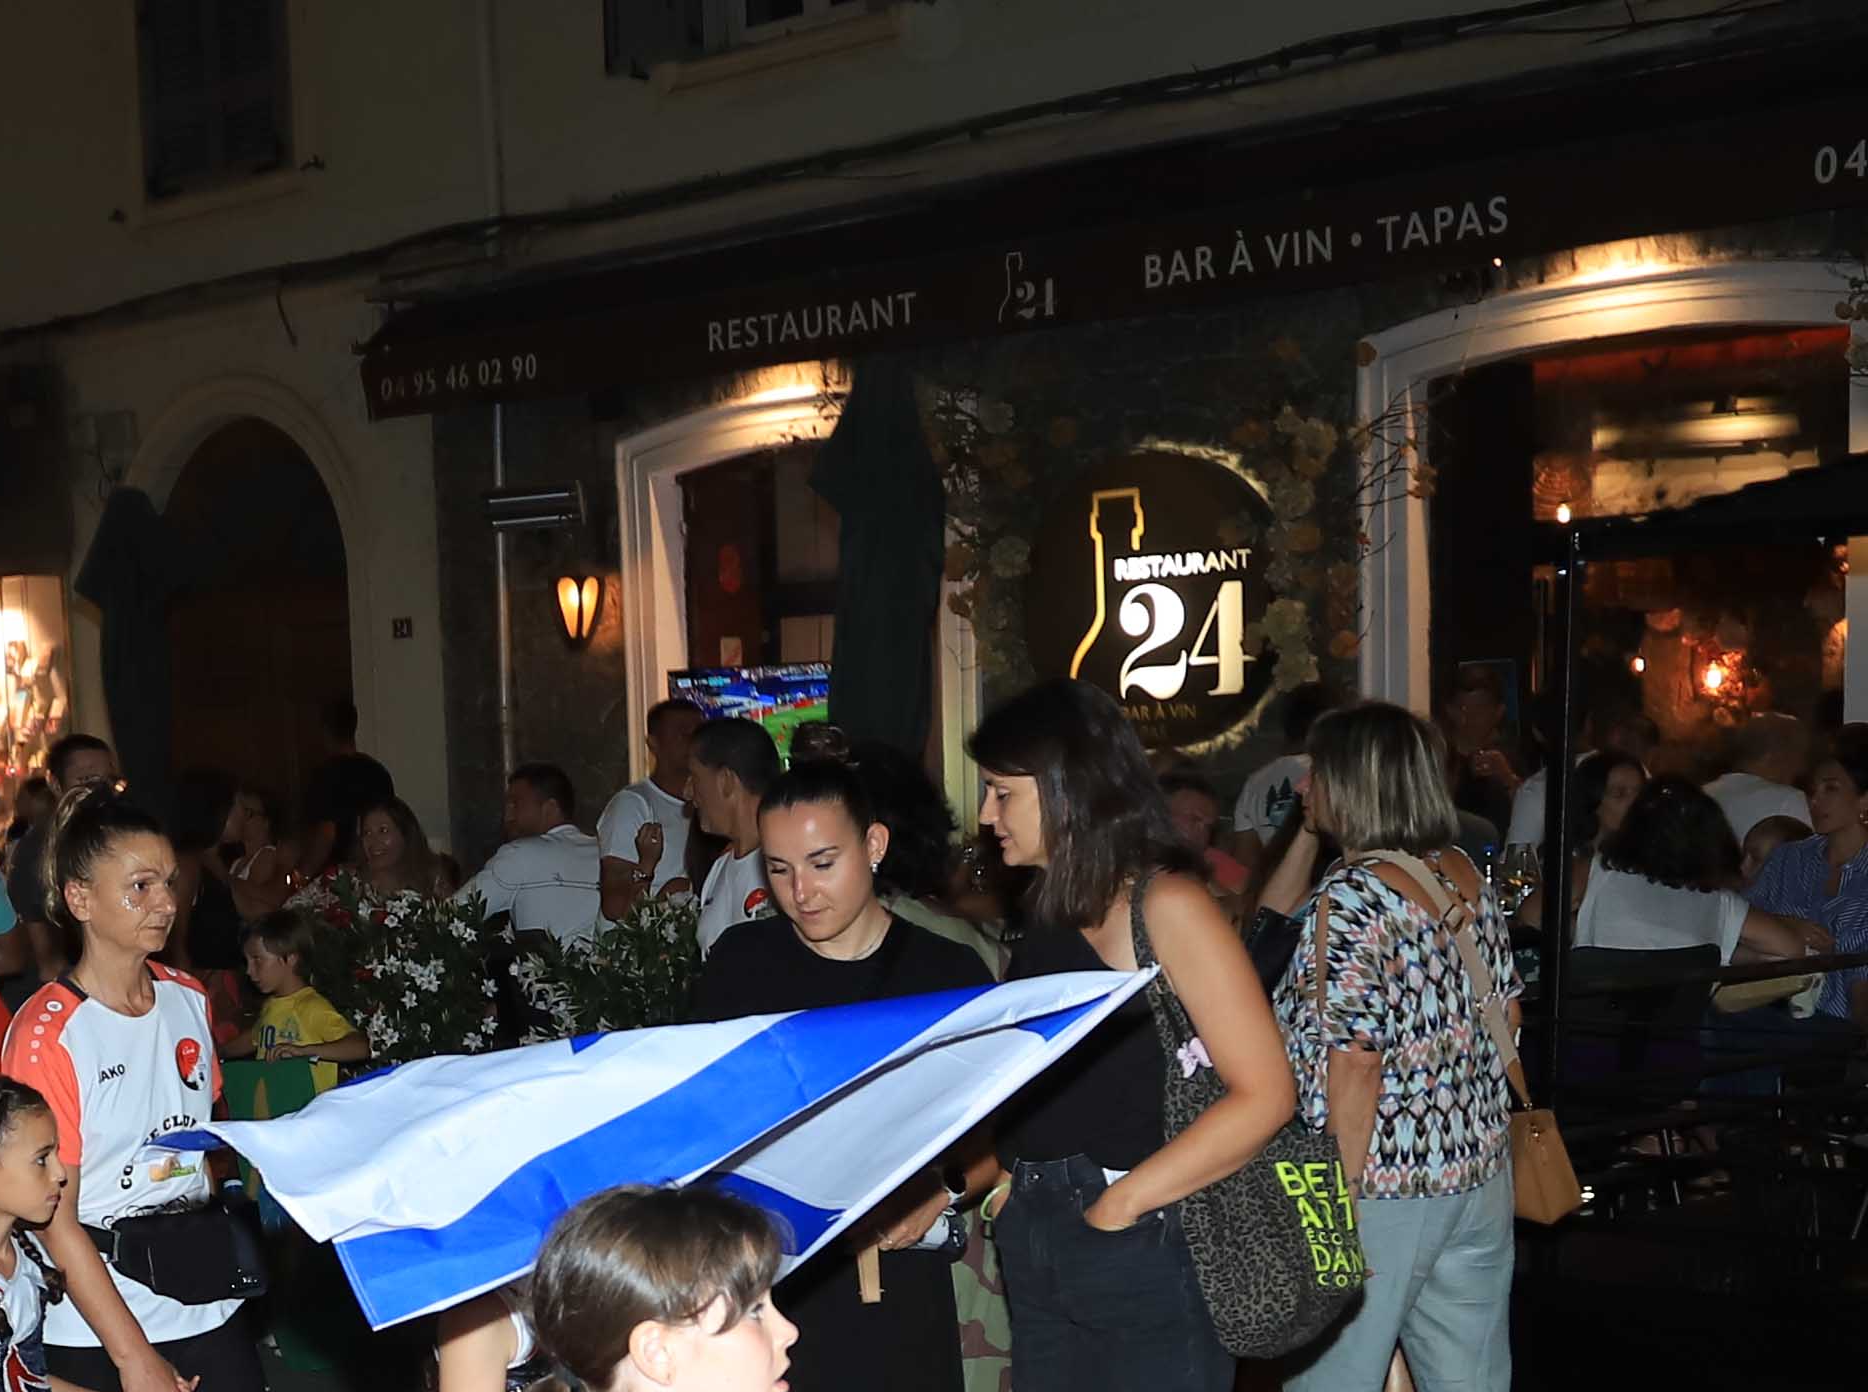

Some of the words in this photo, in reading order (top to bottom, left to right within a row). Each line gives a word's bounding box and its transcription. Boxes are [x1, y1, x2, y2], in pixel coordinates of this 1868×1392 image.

[1814, 138, 1868, 184] 04
[1144, 244, 1216, 290] BAR
[1229, 229, 1256, 274] À
[1266, 225, 1333, 270] VIN
[1376, 196, 1510, 253] TAPAS
[706, 291, 918, 354] RESTAURANT
[413, 368, 437, 397] 95
[445, 363, 470, 391] 46
[477, 357, 503, 387] 02
[511, 352, 538, 383] 90
[1113, 548, 1253, 582] RESTAURANT
[1119, 579, 1258, 701] 24
[1169, 703, 1197, 721] VIN
[98, 1063, 126, 1085] AKO
[1306, 1228, 1344, 1246] ECO
